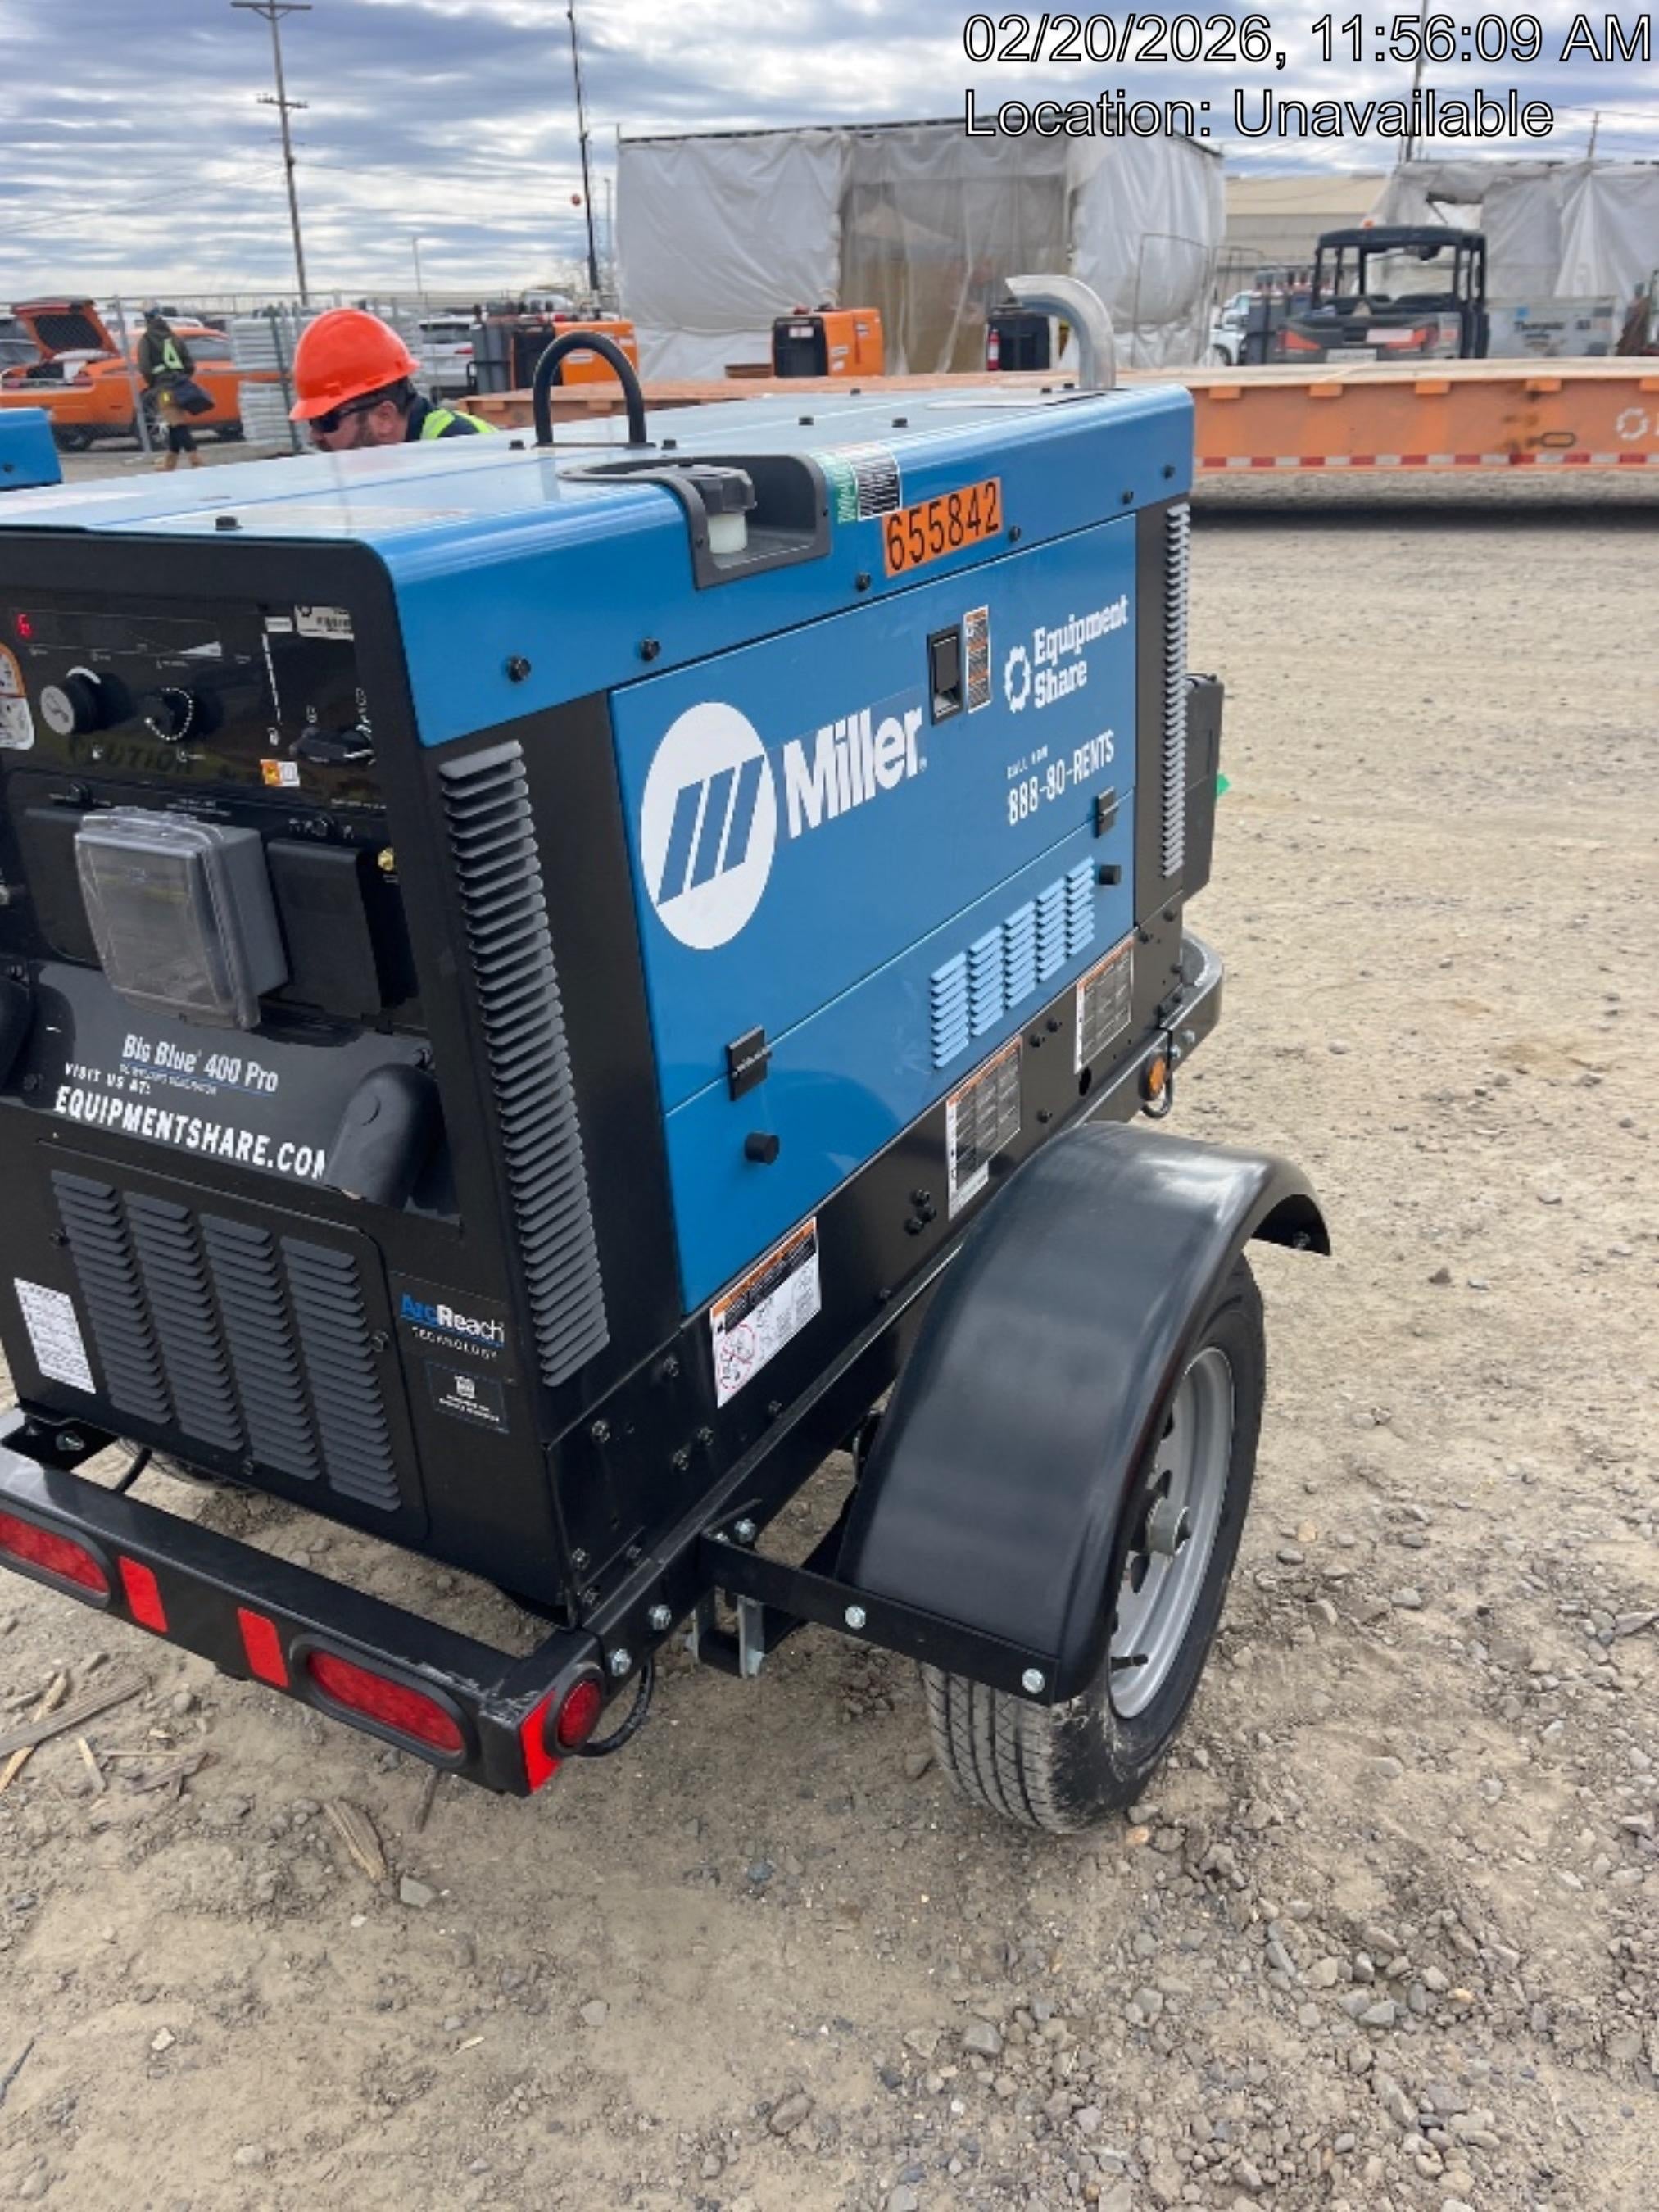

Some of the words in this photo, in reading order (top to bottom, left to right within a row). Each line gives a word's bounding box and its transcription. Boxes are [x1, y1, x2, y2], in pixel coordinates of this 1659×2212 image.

[886, 481, 999, 571] 655842
[1034, 594, 1128, 666] Equipment
[1034, 660, 1088, 709] Share
[1008, 728, 1115, 827] 888-80-RENTS
[65, 1062, 100, 1083] VISIT
[107, 1073, 125, 1089] US
[204, 1054, 242, 1084] 400
[245, 1061, 279, 1092] Pro
[401, 1293, 505, 1344] ArcReach
